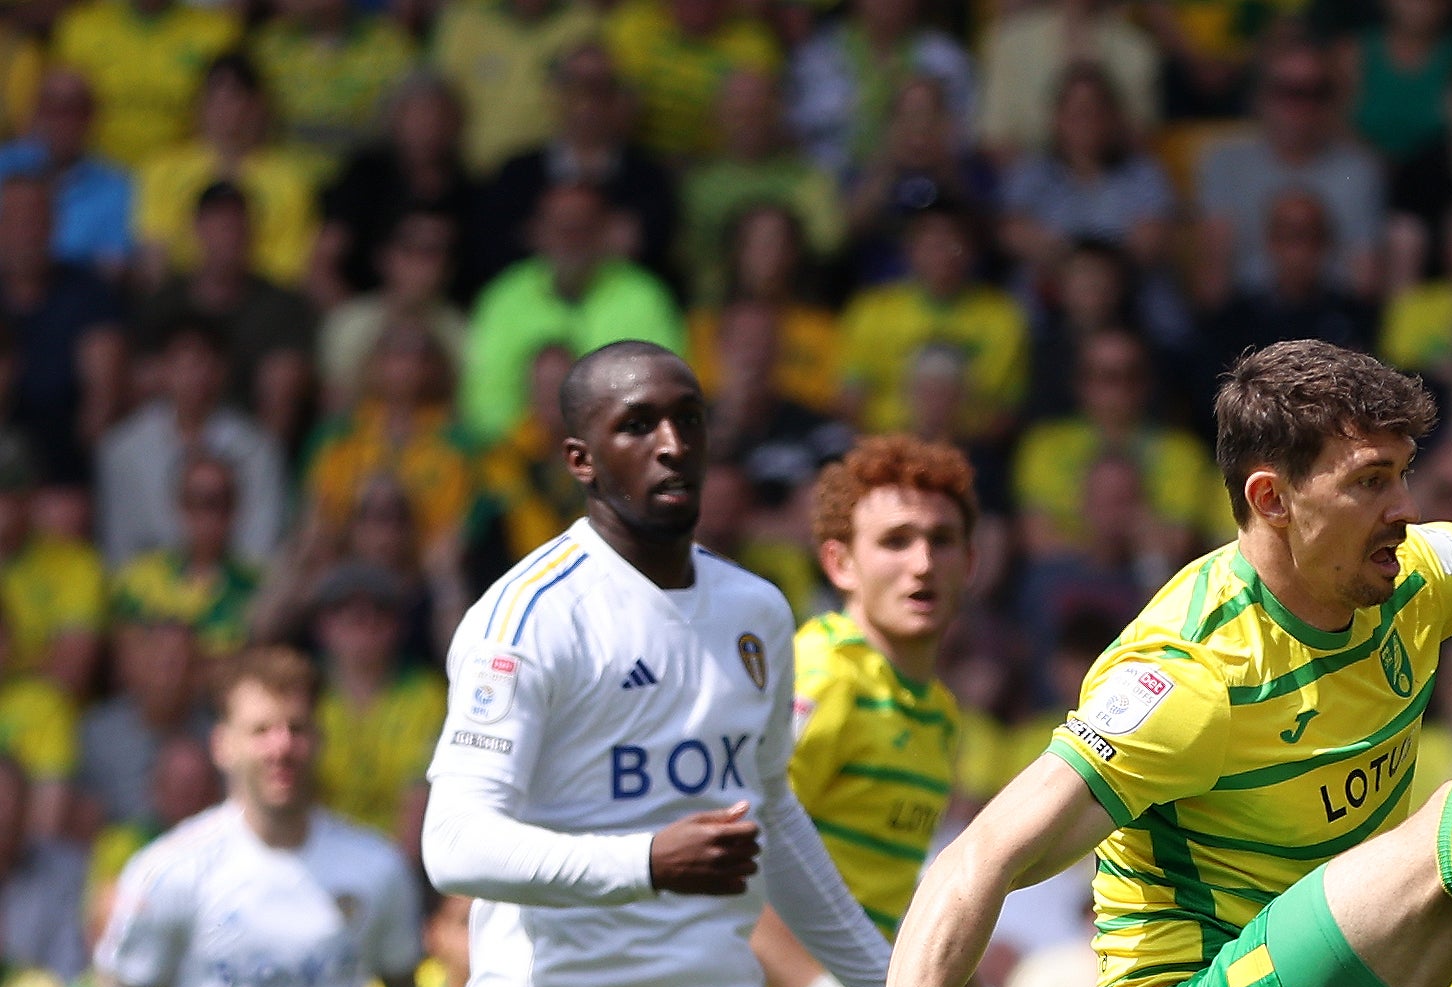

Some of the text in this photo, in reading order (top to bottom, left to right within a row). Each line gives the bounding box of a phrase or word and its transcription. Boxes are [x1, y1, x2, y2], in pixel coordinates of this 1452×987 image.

[1141, 672, 1165, 694] bet
[1066, 718, 1115, 761] GETHER
[612, 734, 766, 799] BOX
